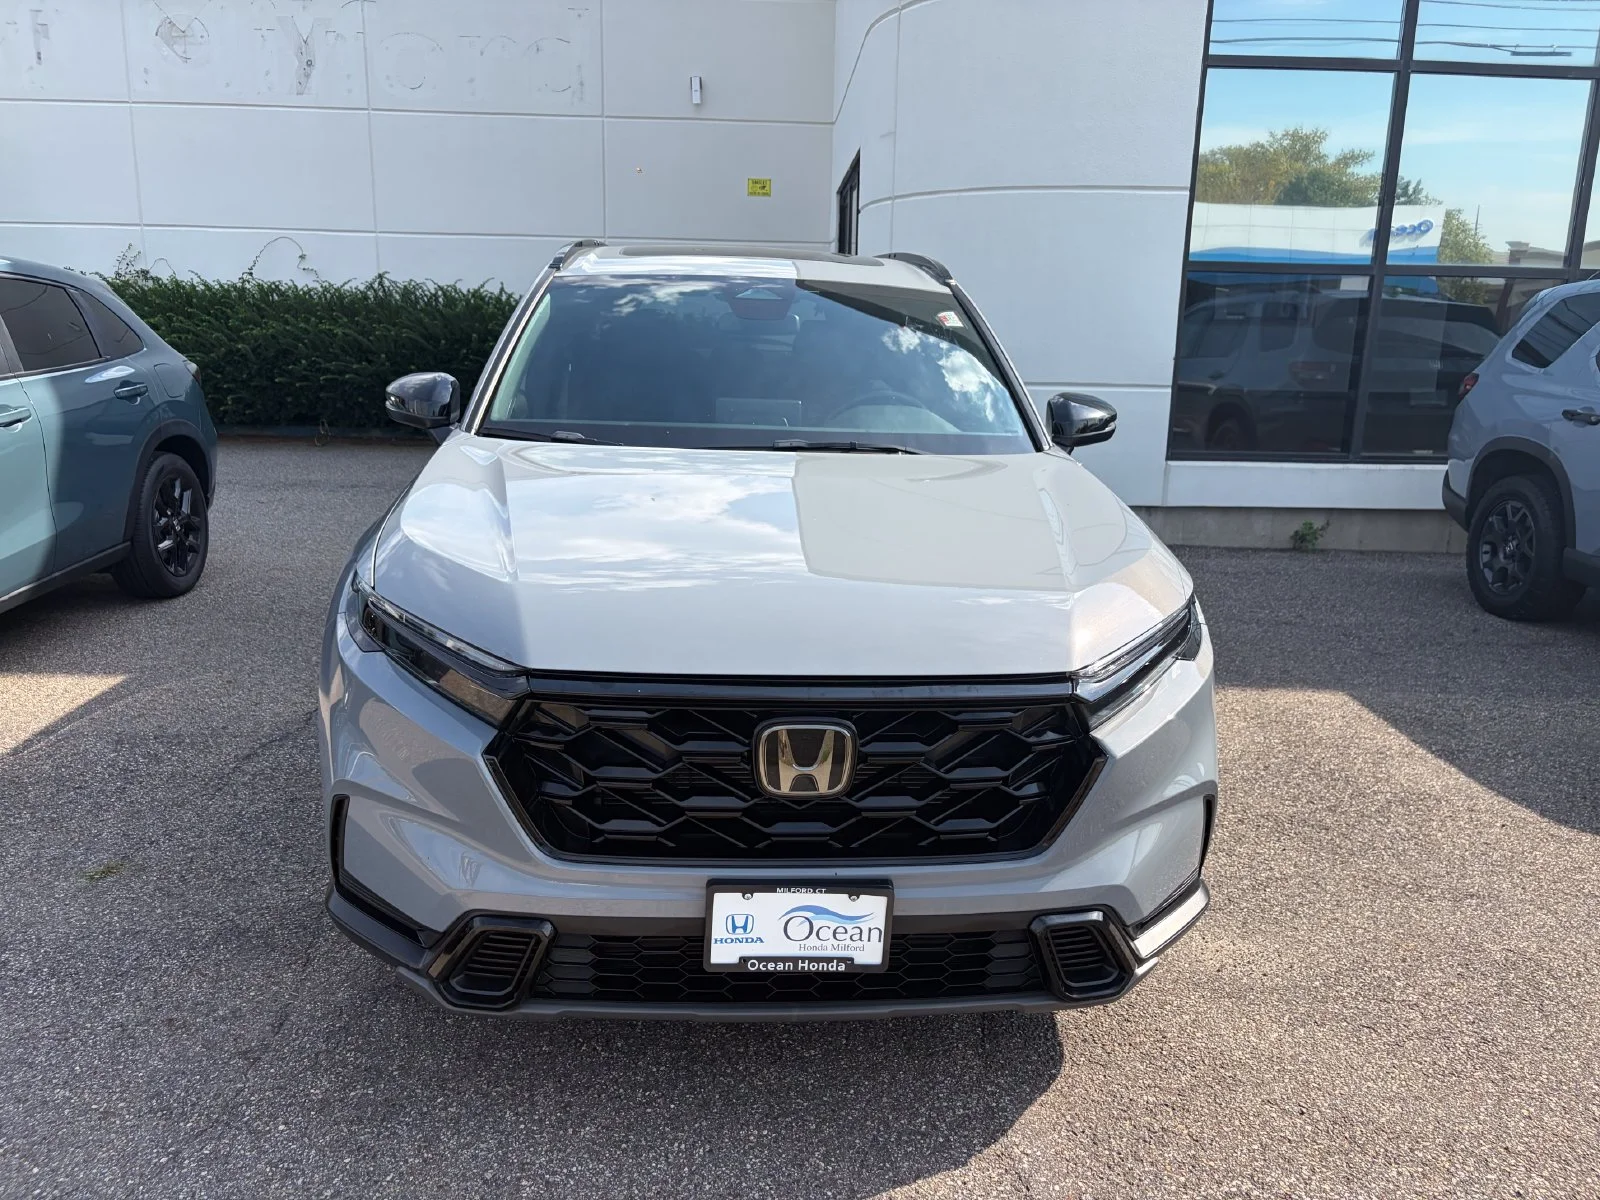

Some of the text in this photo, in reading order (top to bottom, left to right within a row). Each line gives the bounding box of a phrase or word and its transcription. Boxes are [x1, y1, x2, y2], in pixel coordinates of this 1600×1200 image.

[783, 915, 882, 943] Ocean
[714, 937, 765, 945] HONDA
[799, 943, 865, 952] Honda Milford
[747, 959, 846, 971] Ocean Honda
